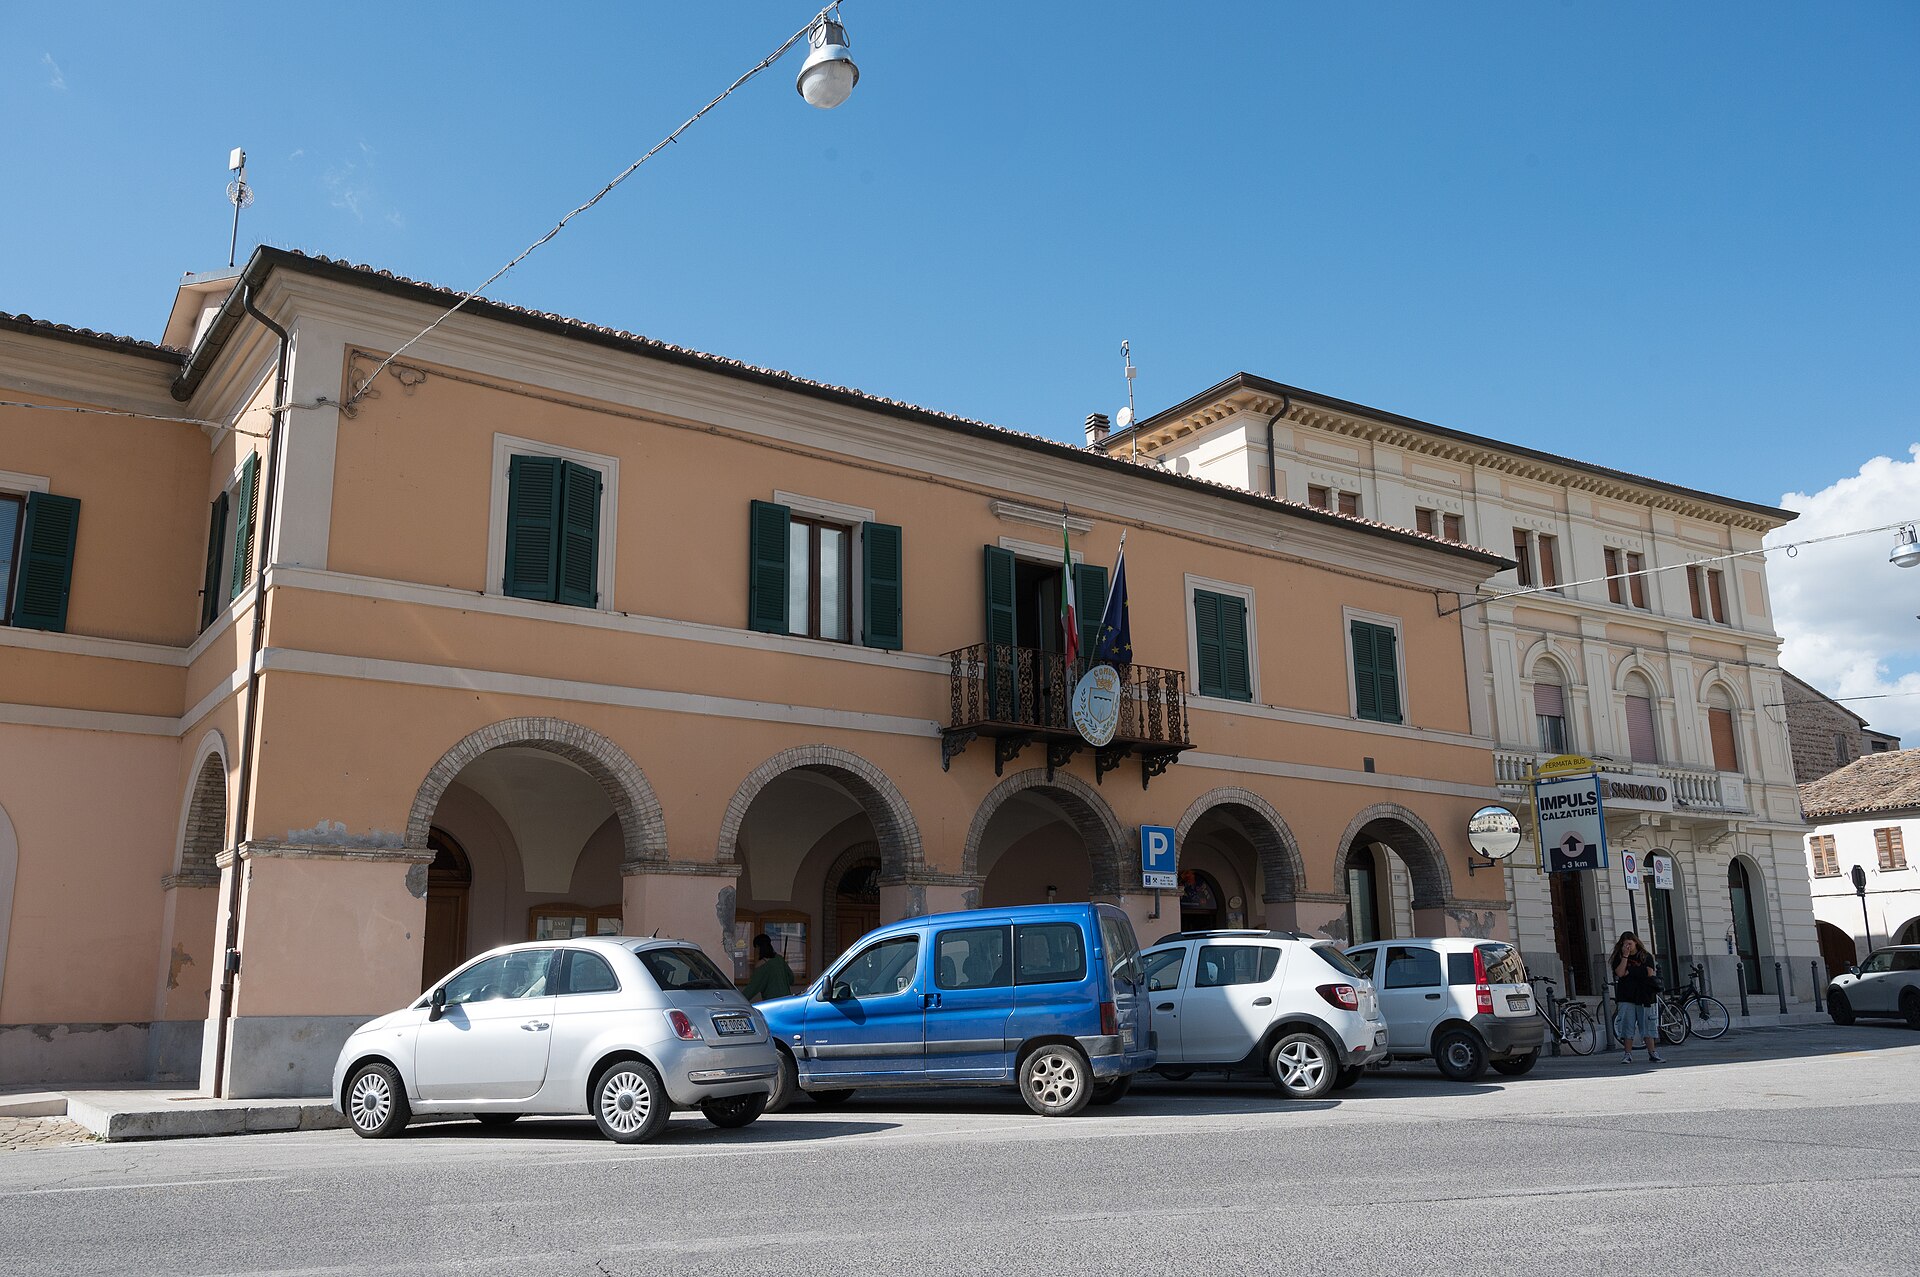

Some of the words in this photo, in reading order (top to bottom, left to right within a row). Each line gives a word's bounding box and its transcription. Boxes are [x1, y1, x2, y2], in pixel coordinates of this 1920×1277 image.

[1545, 760, 1572, 769] FERMATA
[1573, 758, 1586, 766] BUS
[1610, 781, 1668, 802] SANPAOLO
[1540, 791, 1598, 811] IMPULS
[1541, 807, 1598, 821] CALZATURE
[1148, 832, 1168, 867] P
[1574, 860, 1588, 868] km
